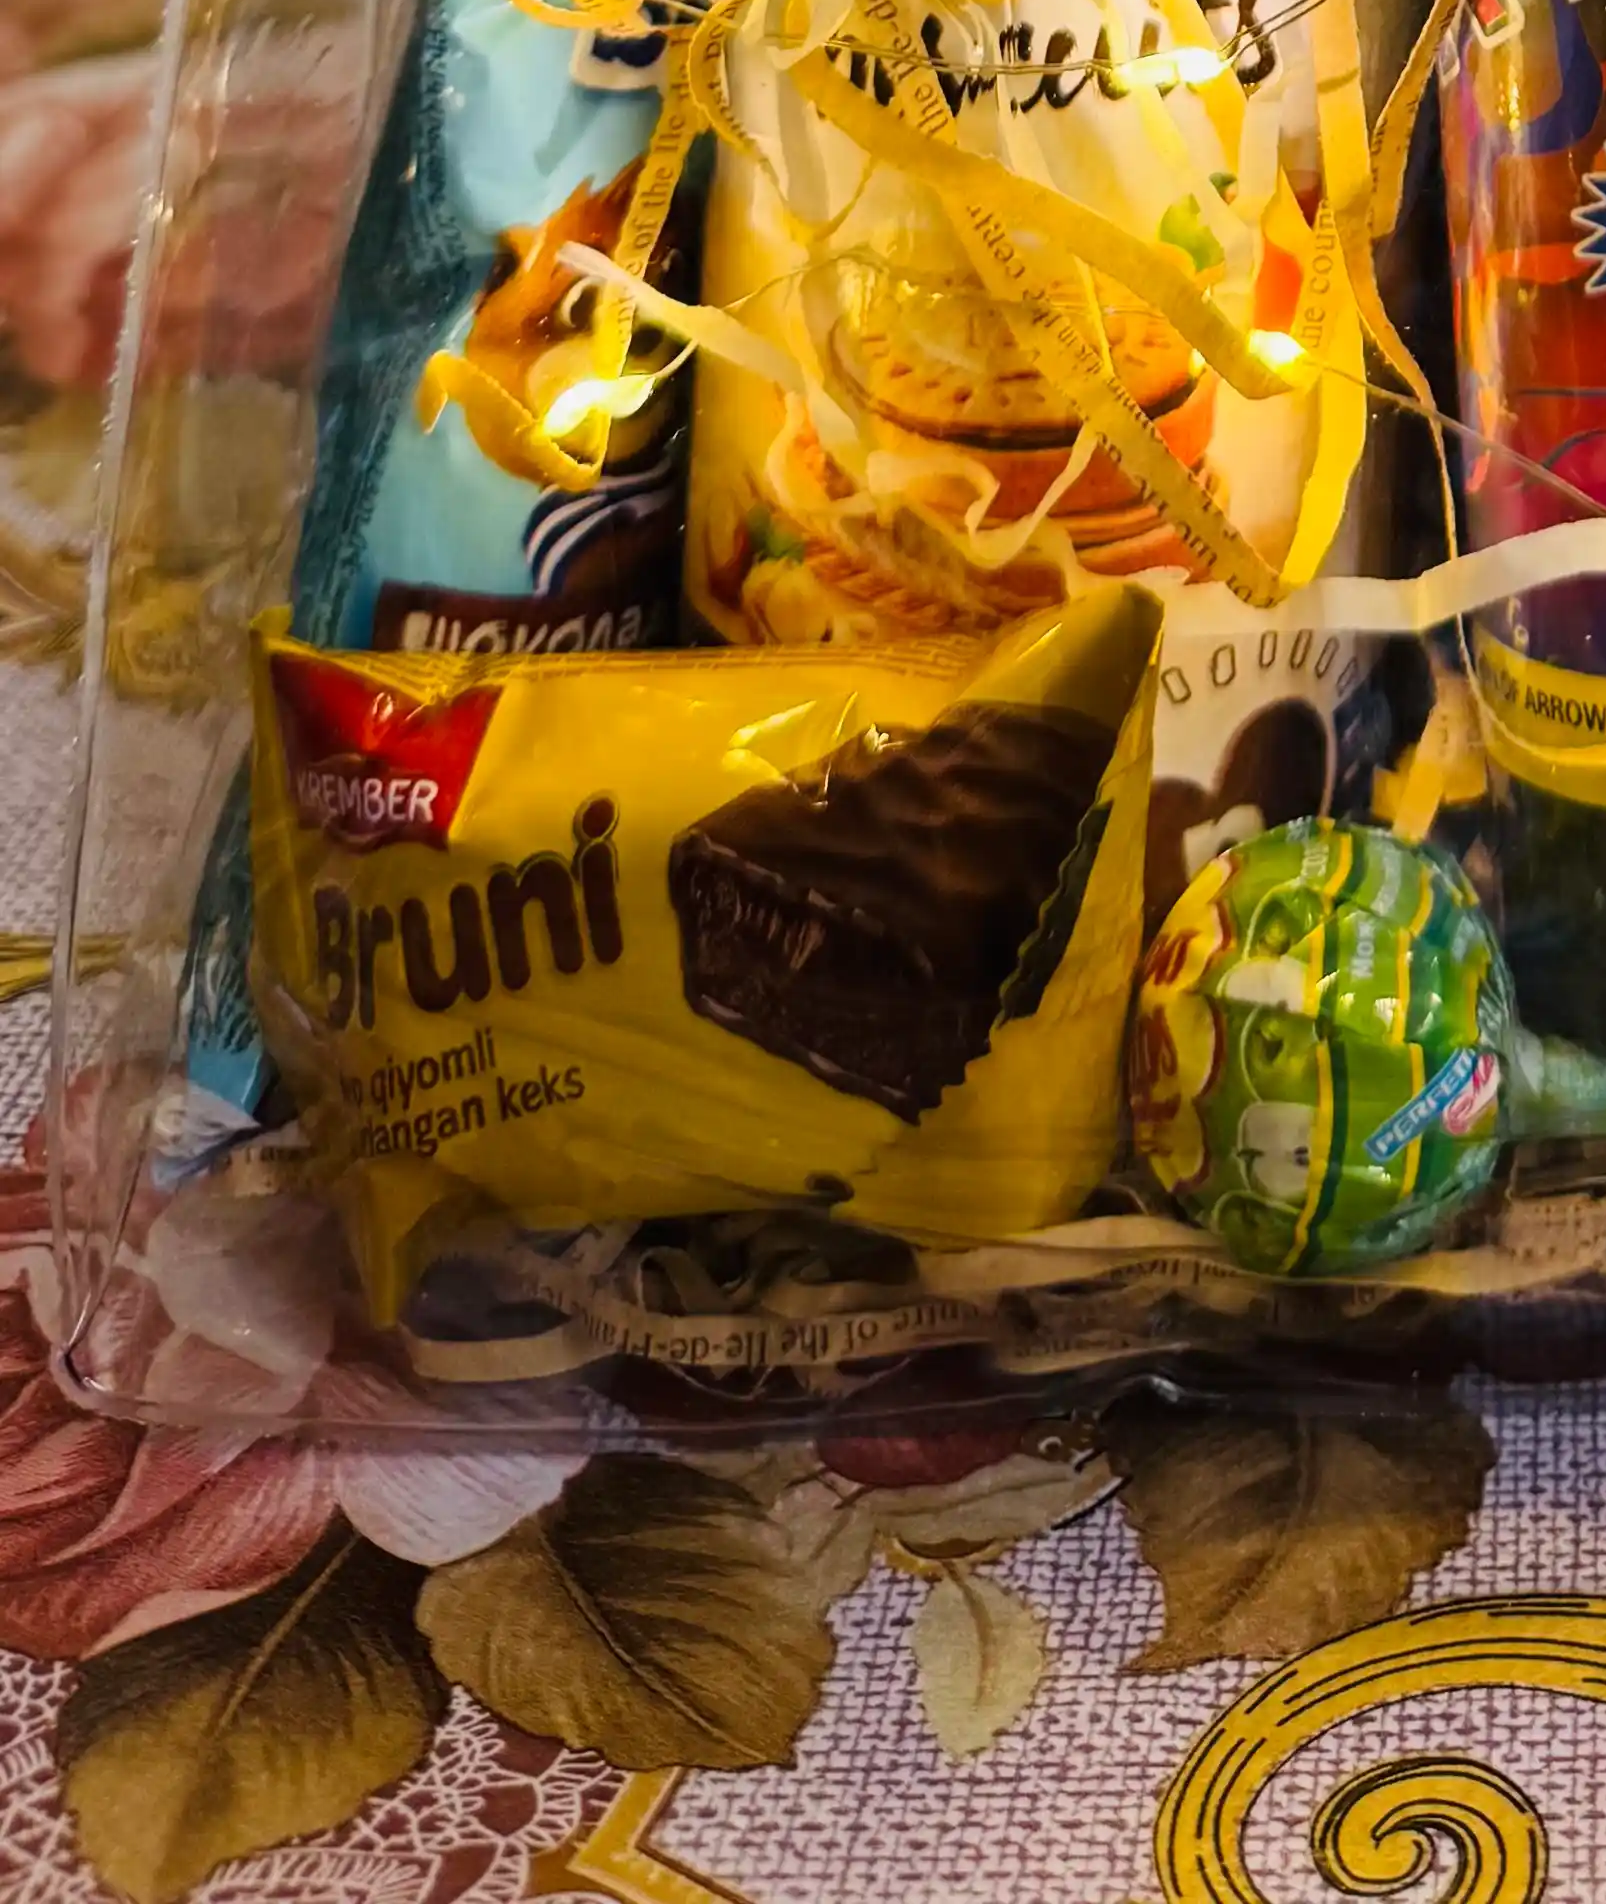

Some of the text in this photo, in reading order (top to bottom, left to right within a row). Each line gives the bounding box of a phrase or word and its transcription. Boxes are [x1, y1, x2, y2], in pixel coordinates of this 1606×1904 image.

[630, 201, 662, 258] of
[650, 147, 680, 202] the
[313, 792, 626, 1033] Bruni
[369, 1027, 497, 1116] qiyomli
[497, 1064, 588, 1123] keks
